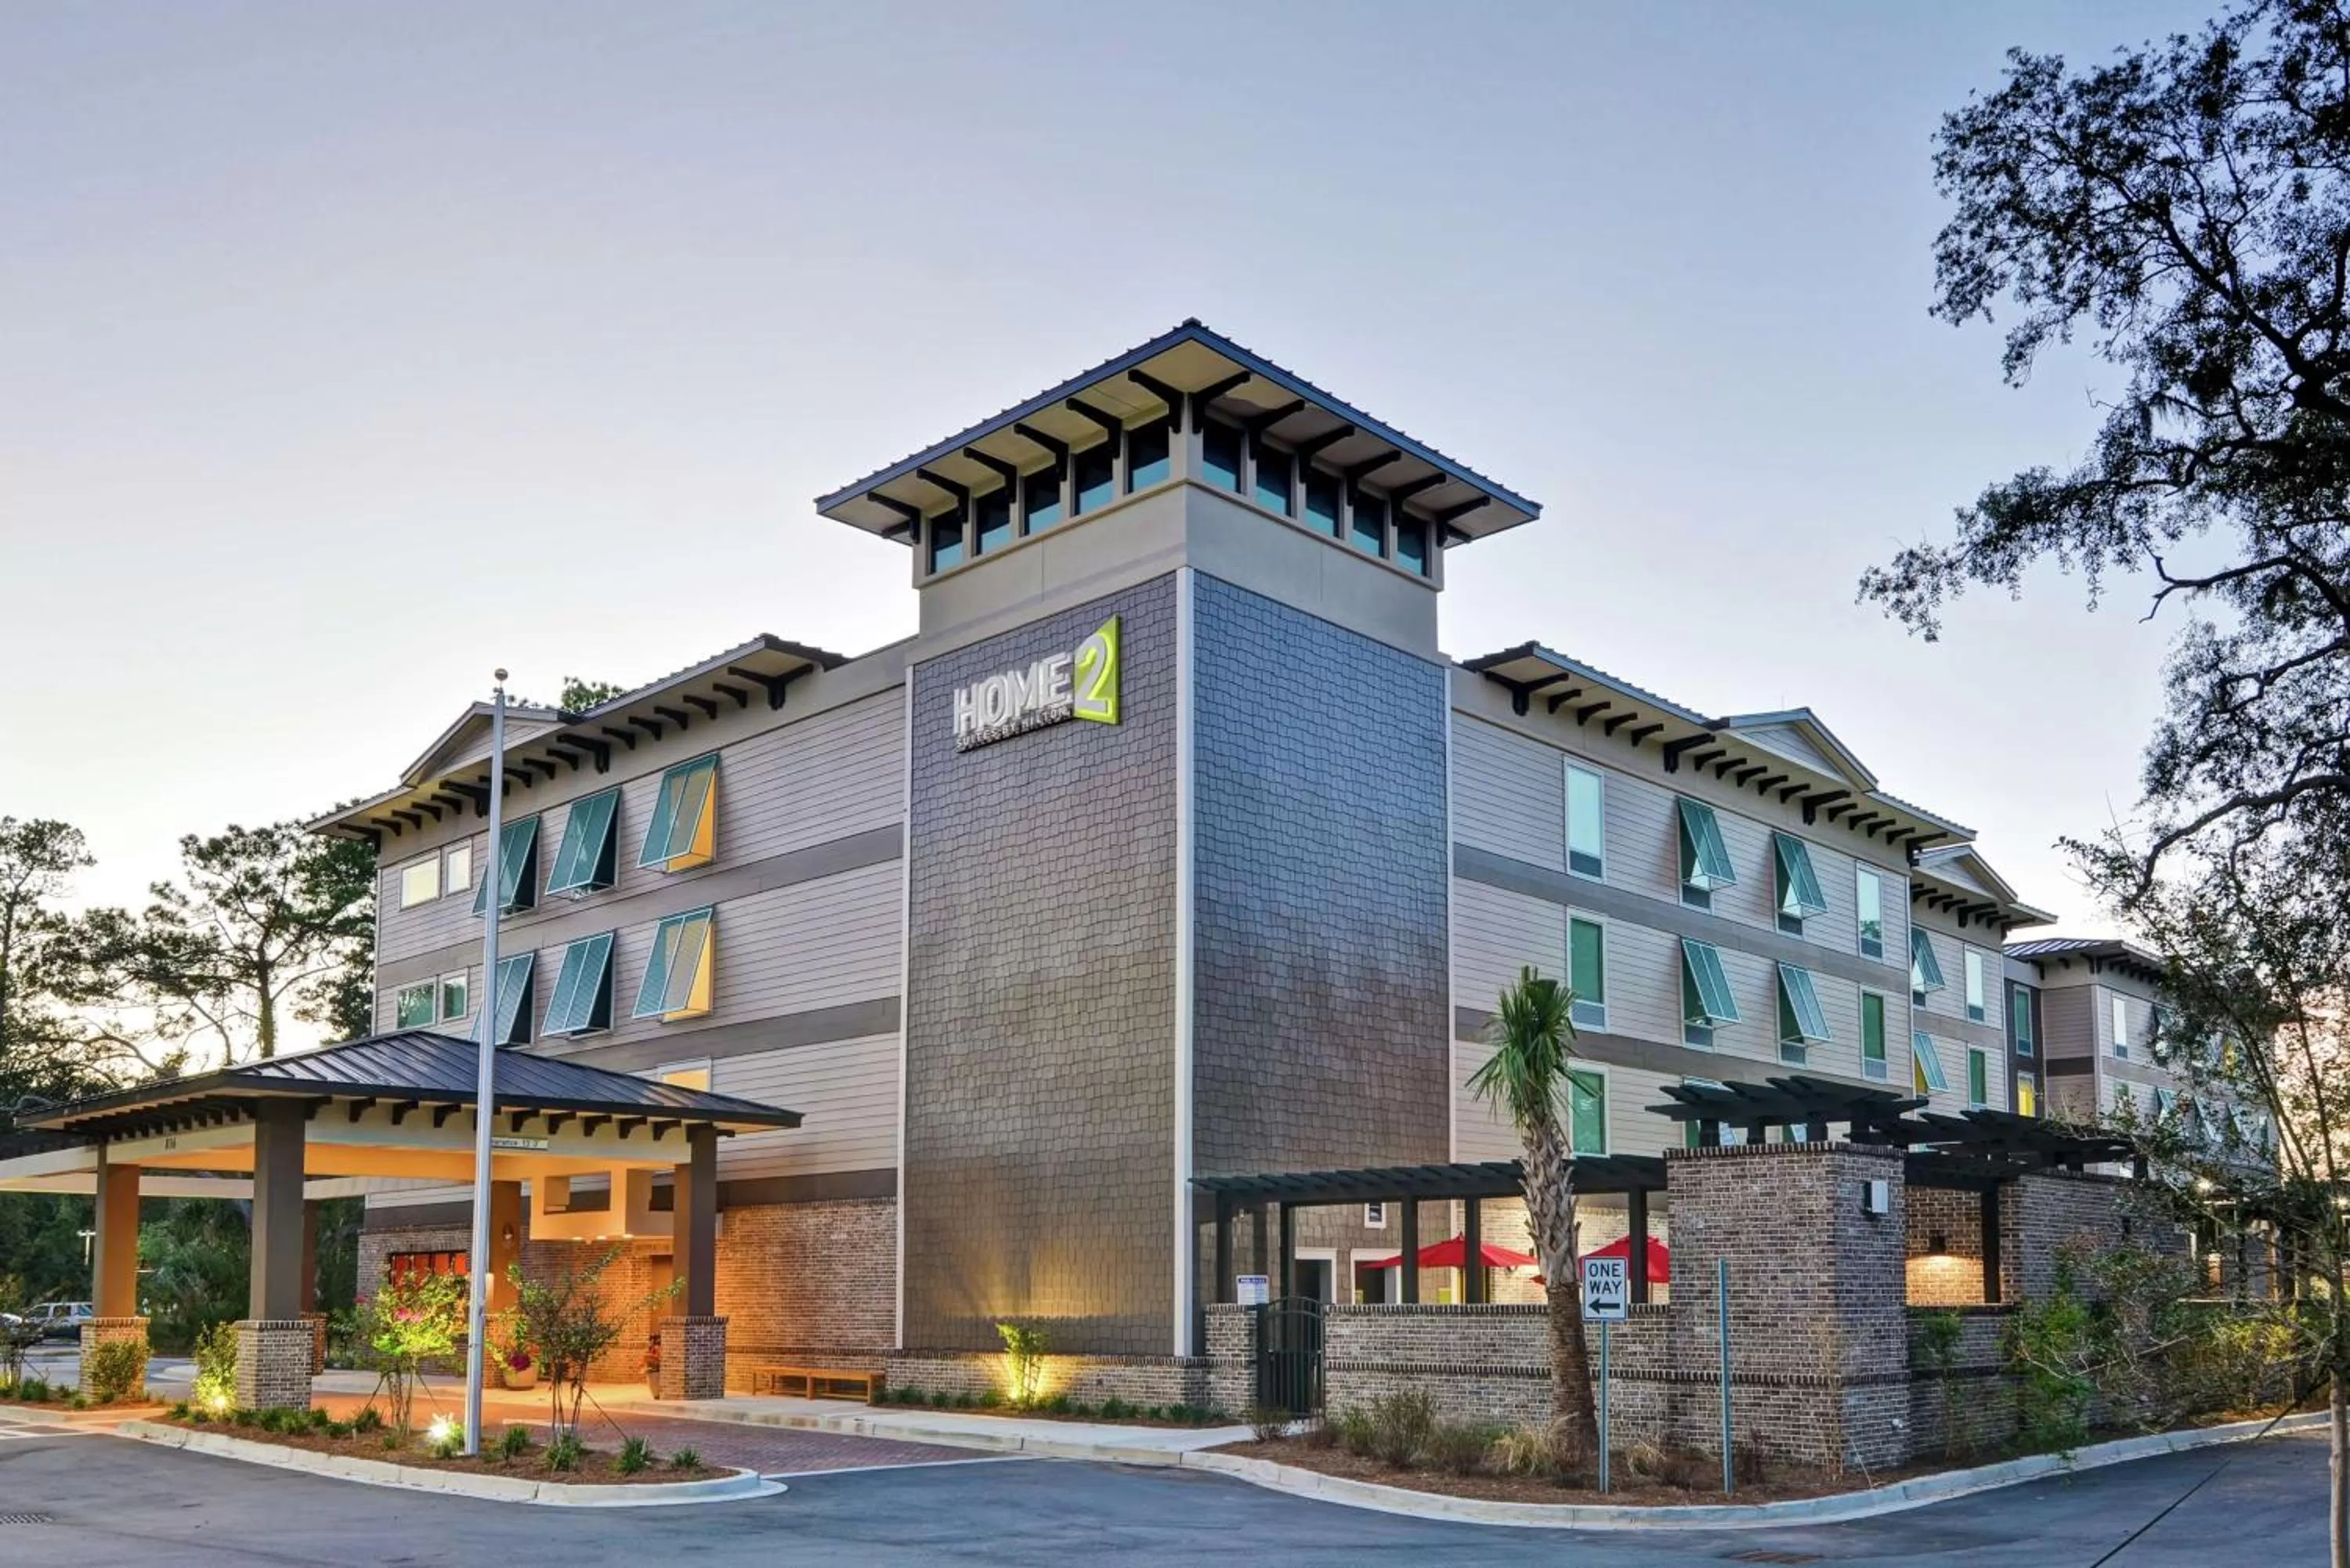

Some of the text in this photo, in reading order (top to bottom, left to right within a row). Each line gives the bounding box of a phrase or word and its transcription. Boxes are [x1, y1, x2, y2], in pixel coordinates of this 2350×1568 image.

[953, 631, 1115, 736] HOME 2
[955, 704, 1069, 748] SUITES BY HILTON
[1589, 1263, 1621, 1277] ONE
[1589, 1280, 1622, 1295] WAY
